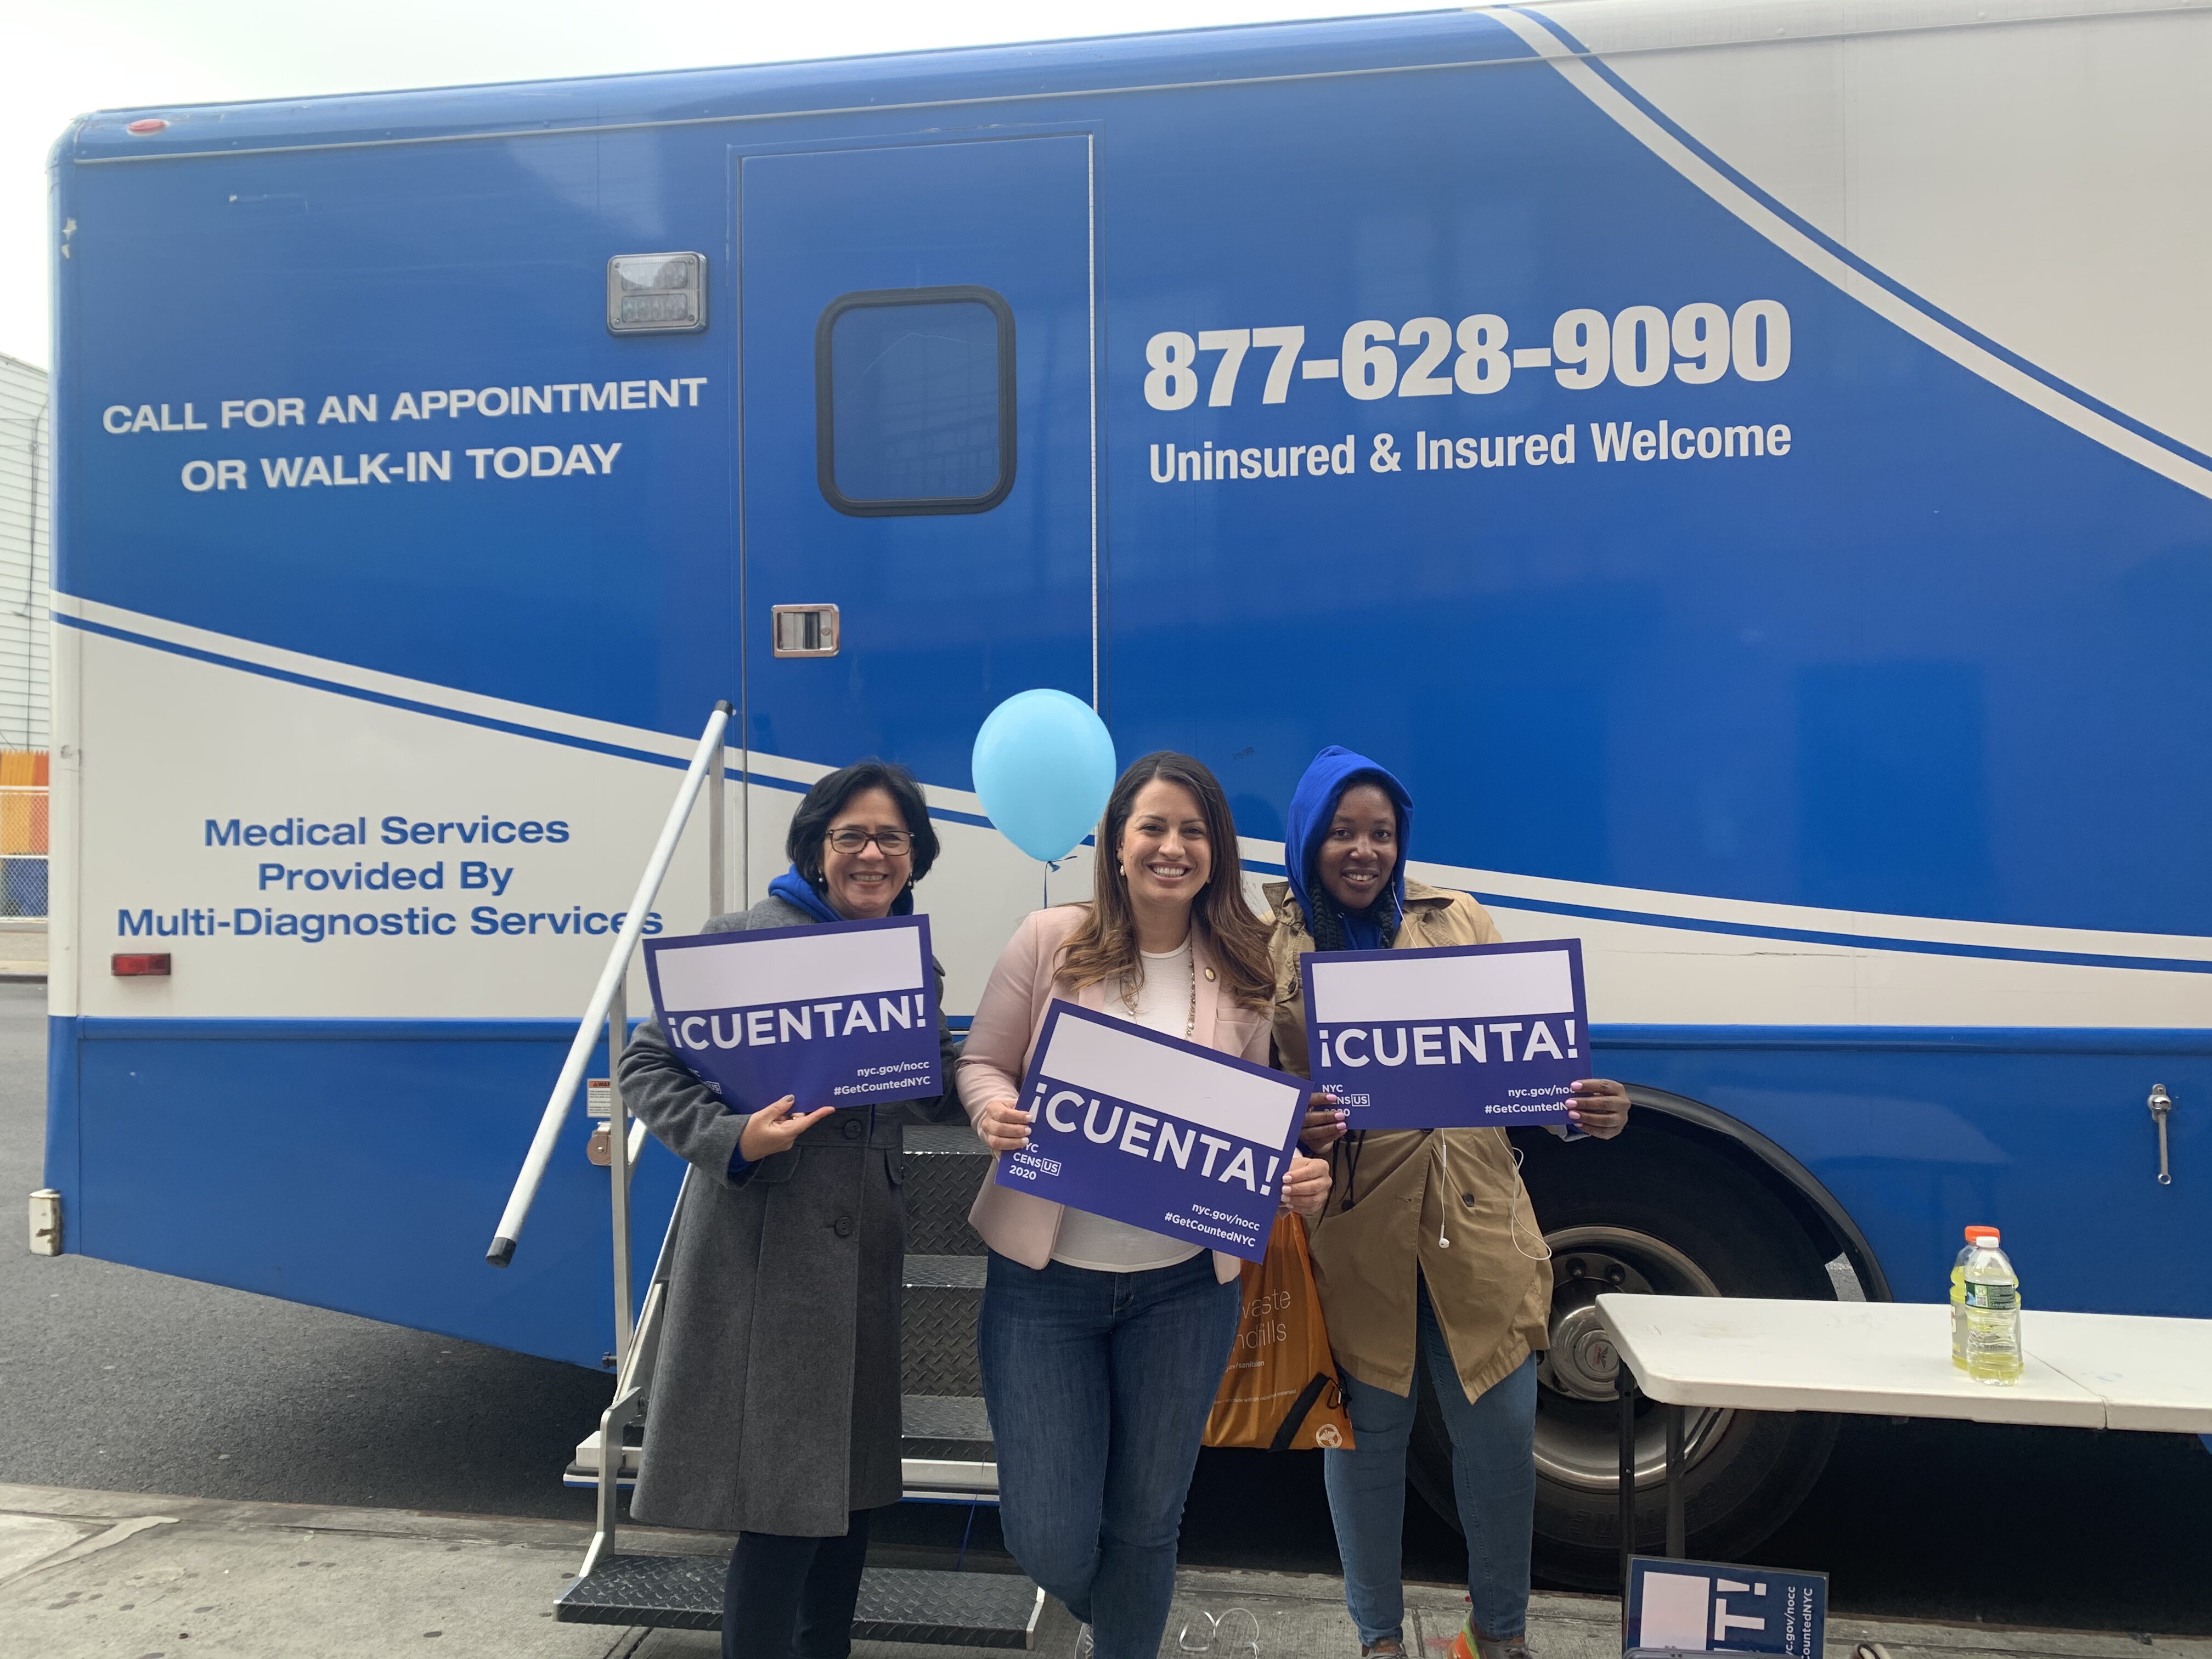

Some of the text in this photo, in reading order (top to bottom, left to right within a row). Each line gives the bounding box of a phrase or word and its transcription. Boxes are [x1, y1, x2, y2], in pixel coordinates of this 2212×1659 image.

[1144, 300, 1791, 410] 877-628-9090
[103, 377, 707, 433] CALL FOR AN APPOINTMENT
[182, 442, 622, 492] OR WALK-IN TODAY
[1150, 420, 1791, 483] Uninsured & Insured Welcome
[206, 816, 569, 847] Medical Services
[259, 861, 513, 896] Provided By
[119, 906, 663, 943] Multi-Diagnostic Services
[668, 994, 926, 1050] ¡CUENTAN!
[1319, 1019, 1578, 1068] ¡CUENTA!
[833, 1076, 931, 1096] #GetCountedNYC
[857, 1061, 929, 1077] nyc.gov/nocc
[1322, 1084, 1344, 1093] NYC
[1022, 1143, 1039, 1153] YC
[1028, 1082, 1280, 1196] ¡CUENTA!
[1009, 1165, 1037, 1180] 2020
[1013, 1153, 1060, 1175] CENSUS
[1164, 1212, 1256, 1247] #GetCountedNYC
[1192, 1203, 1261, 1231] nyc.gov/nocc
